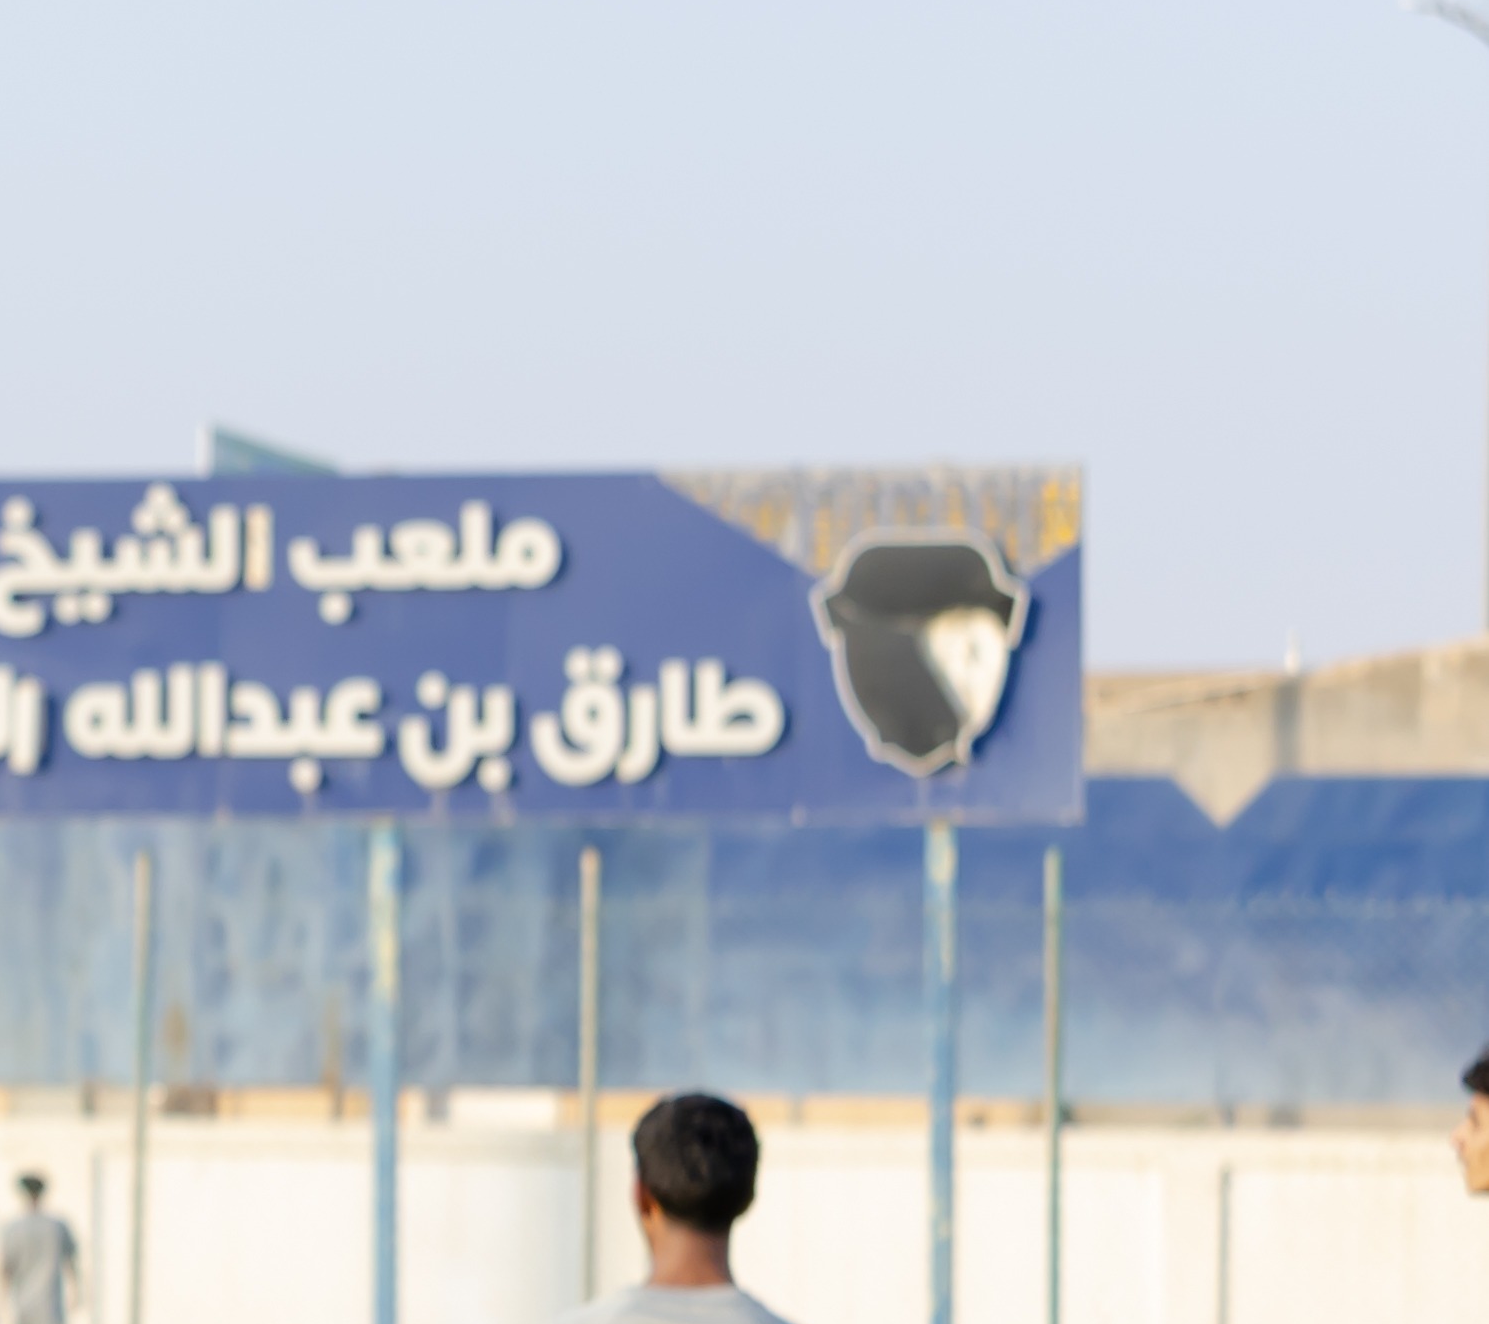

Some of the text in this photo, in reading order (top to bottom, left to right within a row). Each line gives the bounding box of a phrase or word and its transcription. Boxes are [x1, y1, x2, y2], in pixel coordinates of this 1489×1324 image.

[287, 499, 562, 625] ملعب
[63, 660, 387, 794] عبدالله
[397, 669, 517, 795] بن
[529, 644, 786, 787] طارق
